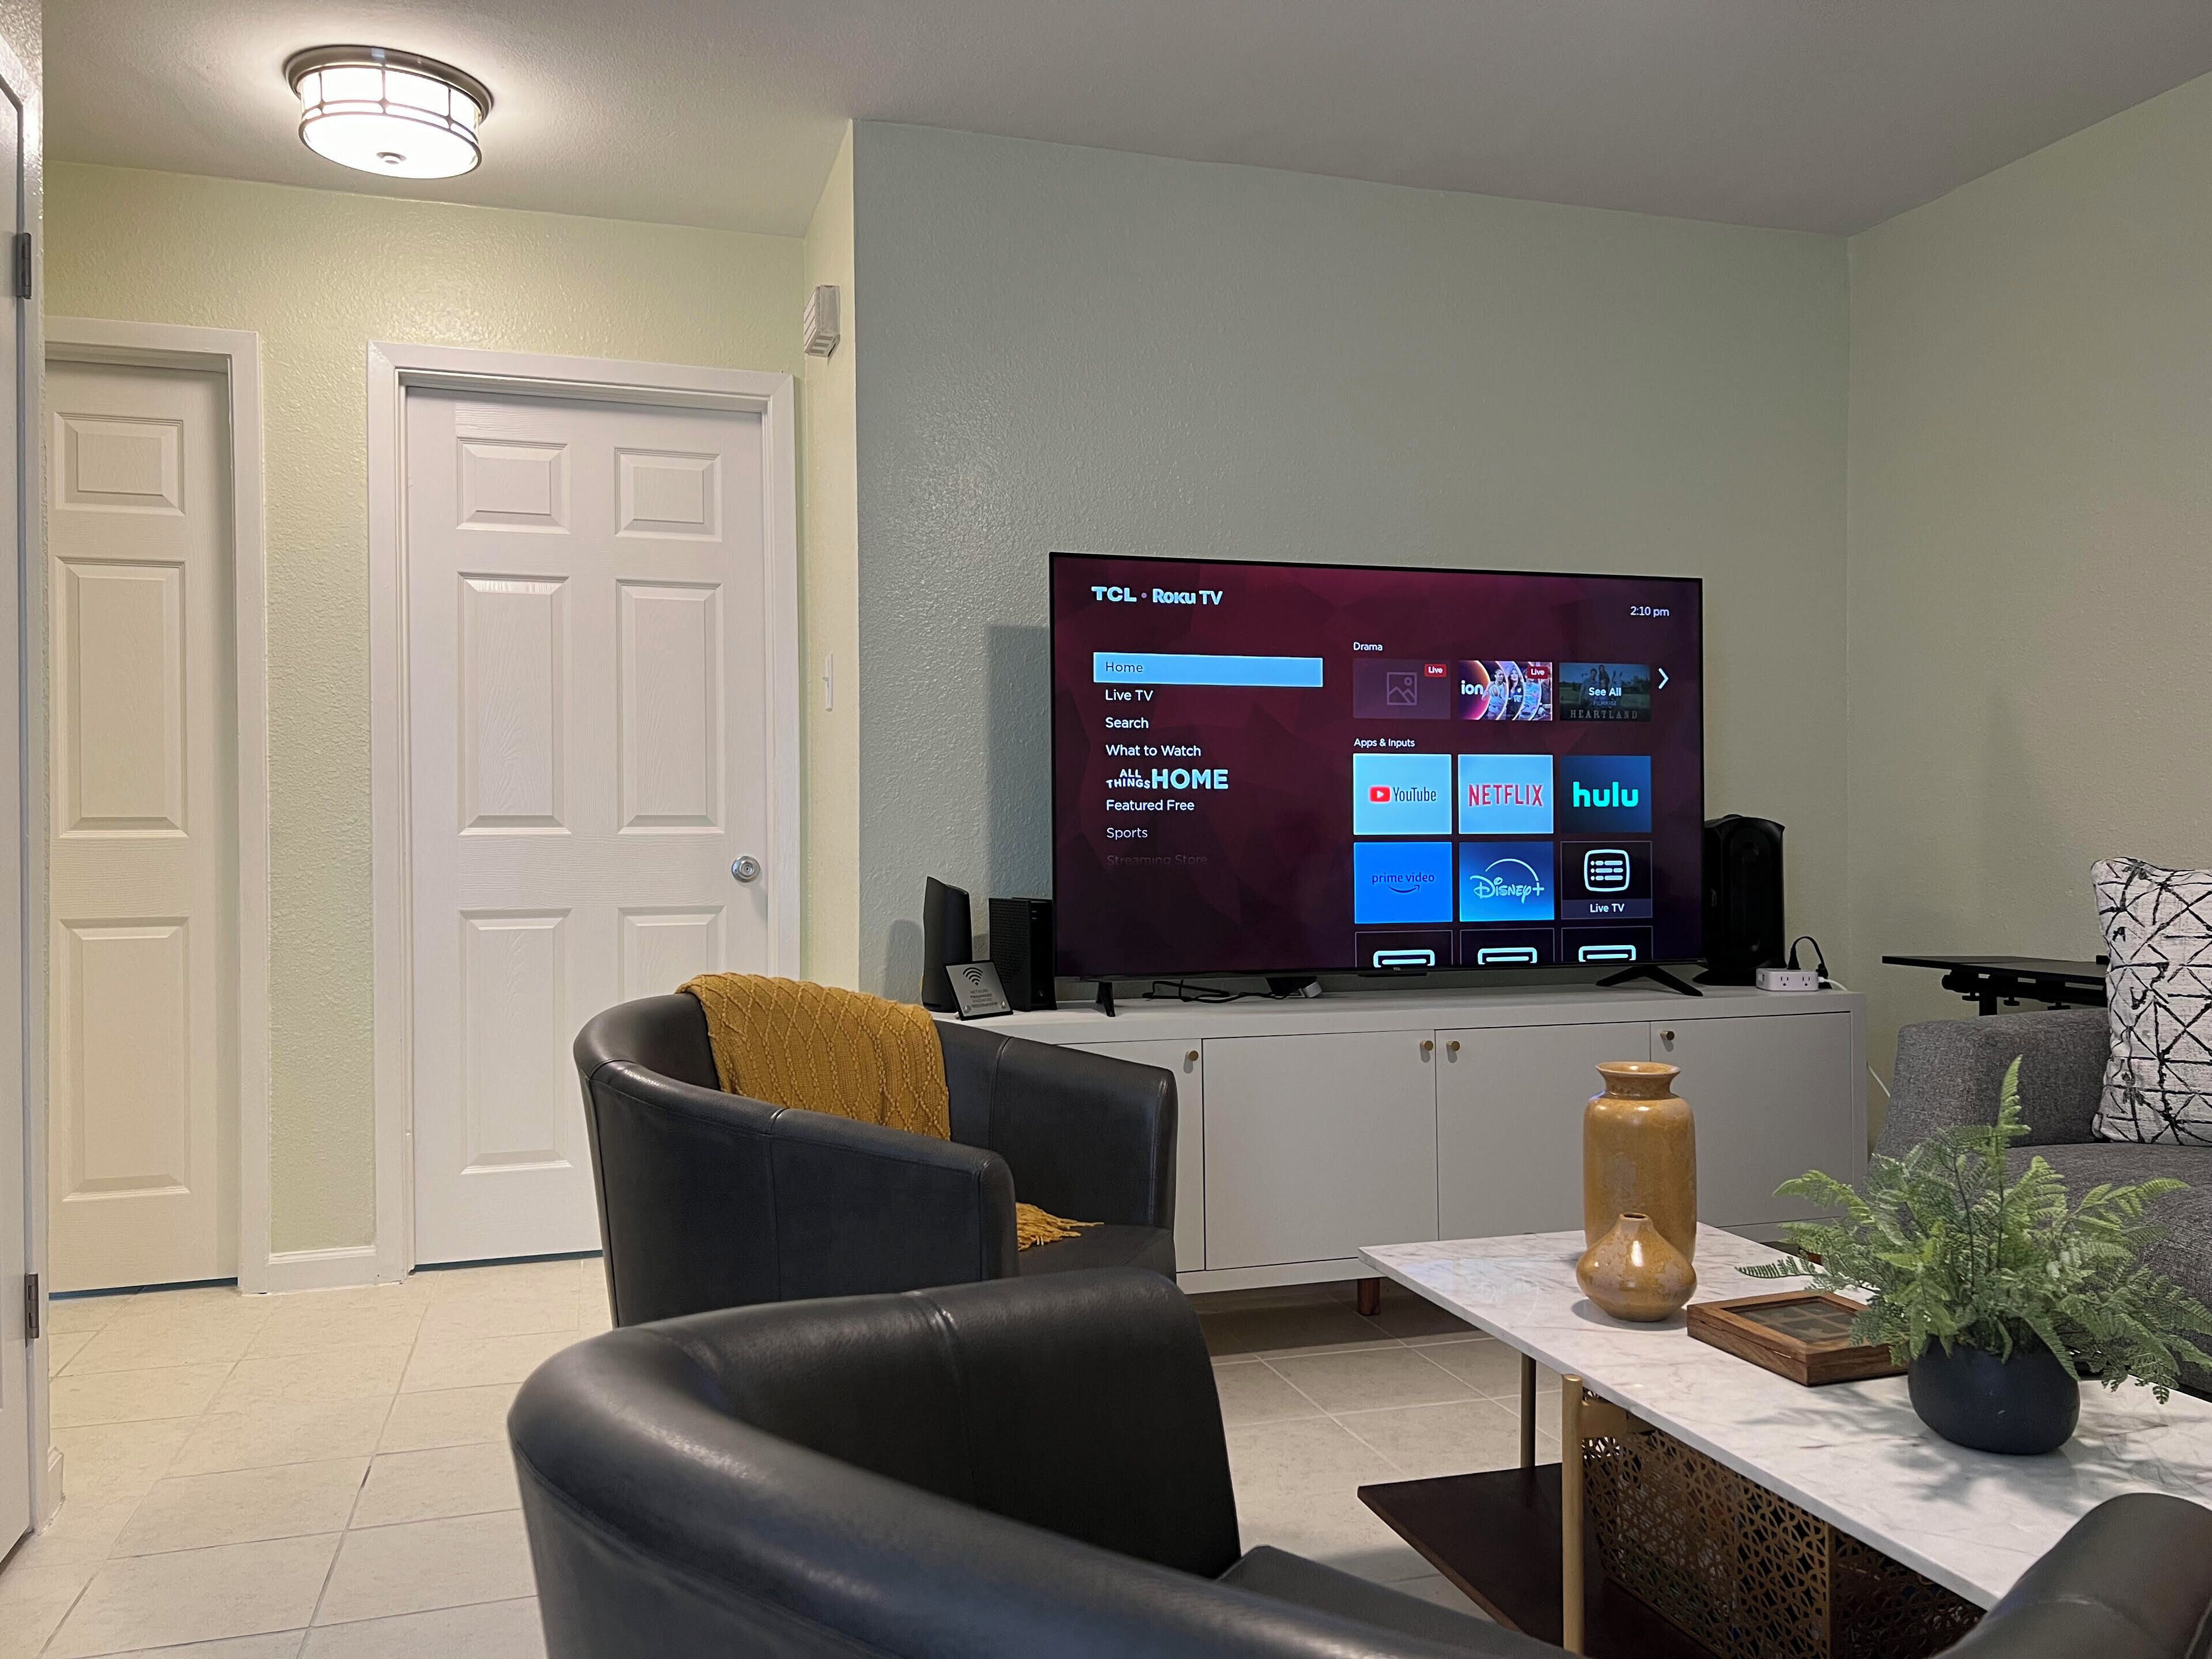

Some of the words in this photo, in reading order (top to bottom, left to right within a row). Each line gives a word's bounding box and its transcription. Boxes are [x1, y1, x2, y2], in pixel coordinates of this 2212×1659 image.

[1092, 586, 1137, 602] TCL
[1153, 589, 1196, 604] Roku
[1199, 590, 1223, 605] TV
[1630, 606, 1650, 616] 2:10
[1653, 608, 1669, 618] pm
[1353, 642, 1383, 652] Drama
[1105, 662, 1143, 673] Home
[1428, 666, 1443, 674] Live
[1461, 680, 1484, 695] ion
[1589, 687, 1606, 696] See
[1609, 687, 1622, 696] All
[1105, 690, 1131, 701] Live
[1135, 691, 1153, 701] TV
[1570, 710, 1638, 719] HEARTLAND
[1105, 717, 1149, 729] Search
[1354, 738, 1377, 748] Apps
[1388, 738, 1415, 749] Inputs
[1106, 745, 1141, 756] What
[1144, 747, 1157, 756] to
[1161, 745, 1202, 757] Watch
[1106, 778, 1151, 789] THINGS
[1152, 768, 1228, 789] HOME
[1120, 769, 1141, 778] ALL
[1393, 787, 1436, 802] YouTube
[1469, 784, 1543, 806] NETFLIX
[1573, 782, 1638, 806] hulu
[1107, 800, 1163, 811] Featured
[1167, 800, 1195, 810] Free
[1107, 827, 1148, 840] Sports
[1175, 855, 1207, 865] Store
[1372, 873, 1403, 884] prime
[1406, 873, 1434, 882] video
[1590, 903, 1608, 913] Live
[1611, 903, 1624, 913] TV
